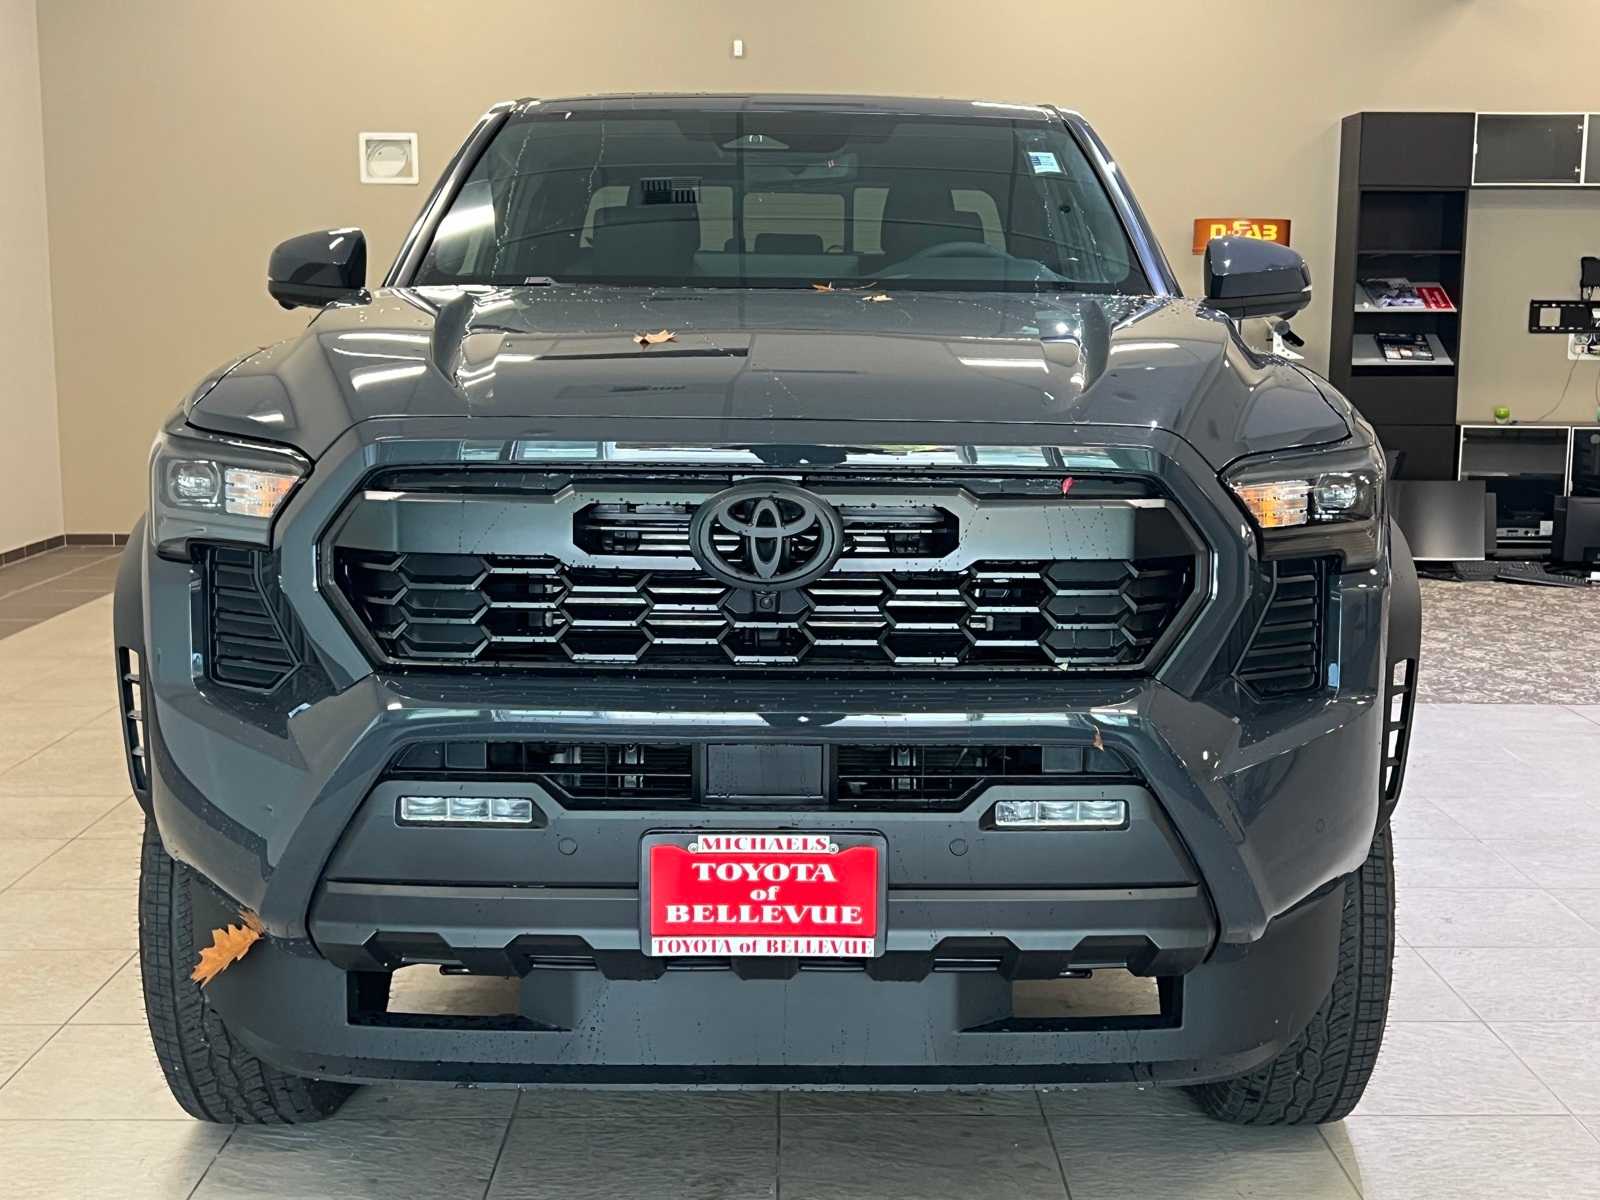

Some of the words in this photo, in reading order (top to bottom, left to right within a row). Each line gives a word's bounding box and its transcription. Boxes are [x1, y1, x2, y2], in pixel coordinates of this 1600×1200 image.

[702, 838, 828, 850] MICHAELS
[691, 862, 837, 882] TOYOTA
[750, 886, 780, 901] of
[665, 904, 863, 924] BELLEVUE
[654, 939, 732, 953] TOYOTA
[739, 938, 758, 953] of
[767, 939, 872, 954] BELLEVUE
